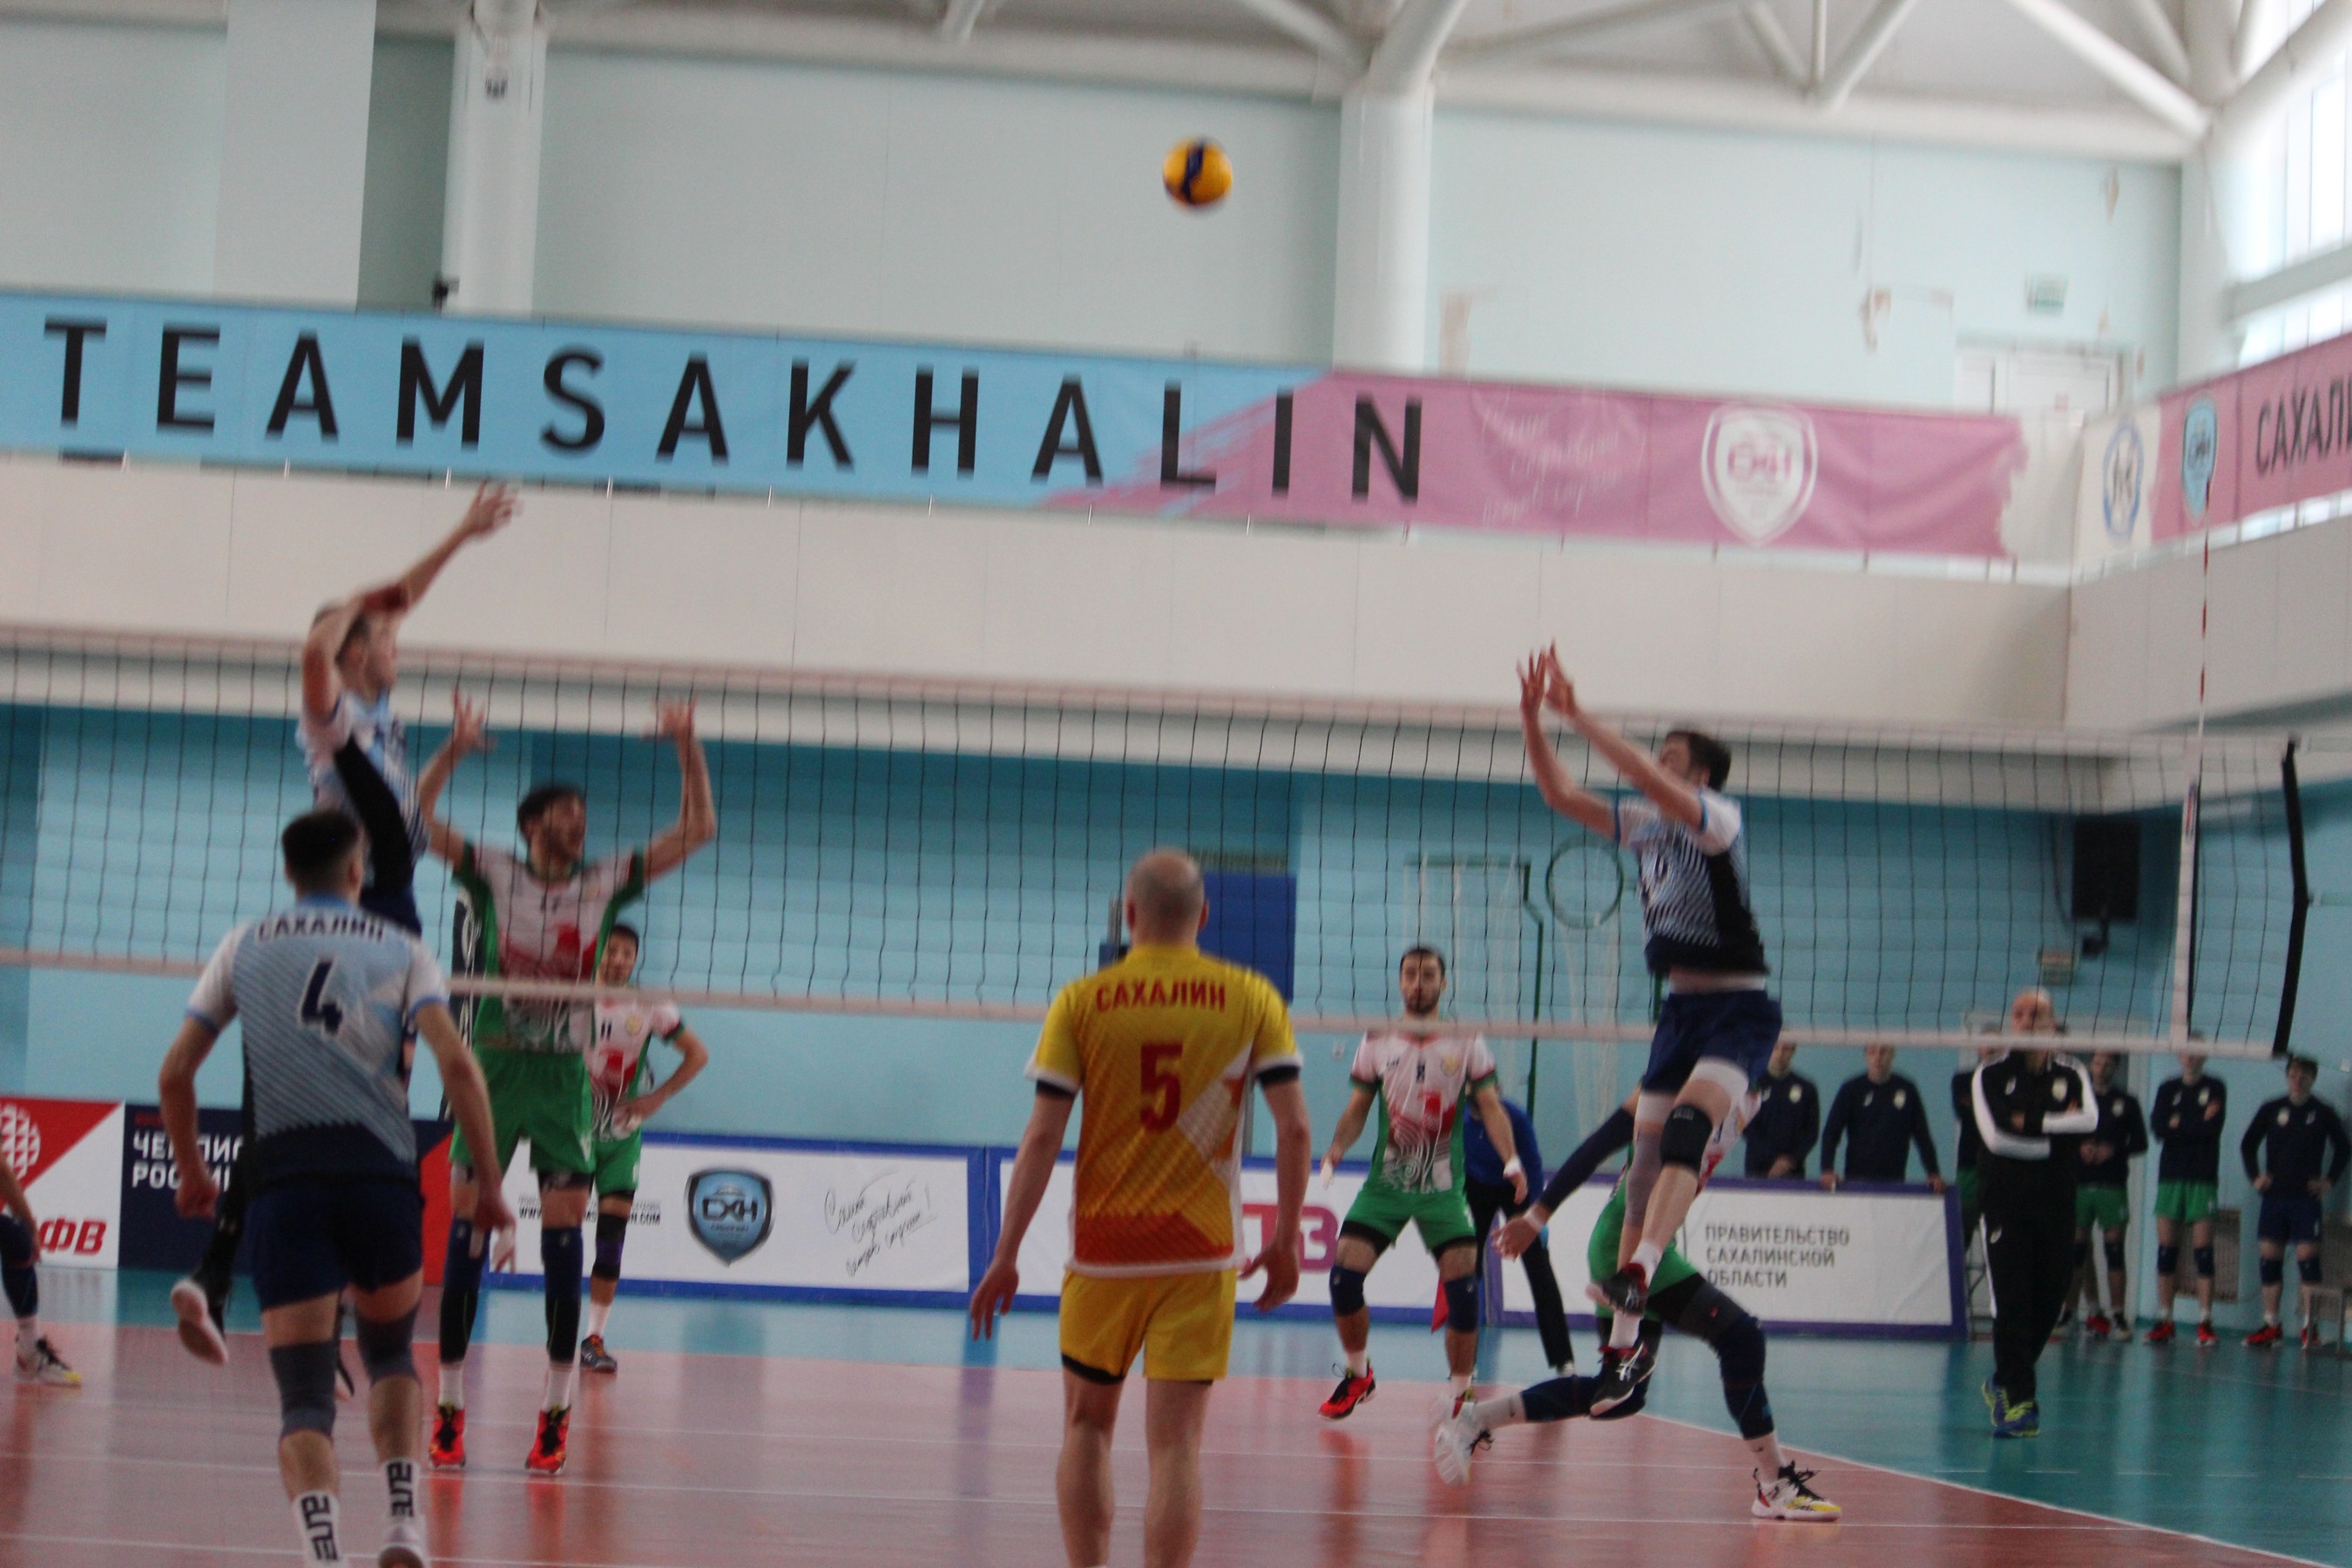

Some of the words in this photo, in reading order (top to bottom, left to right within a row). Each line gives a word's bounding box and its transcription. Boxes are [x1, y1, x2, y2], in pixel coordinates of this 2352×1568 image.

[44, 315, 1423, 505] TEAMSAKHALIN
[259, 913, 384, 943] САХАЛИН
[300, 957, 343, 1034] 4
[1096, 979, 1226, 1012] САХАЛИН
[1139, 1041, 1183, 1132] 5
[133, 1130, 244, 1163] ЧЕПИ
[40, 1216, 107, 1255] ФВ
[1705, 1224, 1851, 1247] ПРАВИТЕЛЬСТВО
[1706, 1246, 1836, 1268] САХАЛИНСКОЙ
[1707, 1268, 1788, 1288] ОБЛАСТИ
